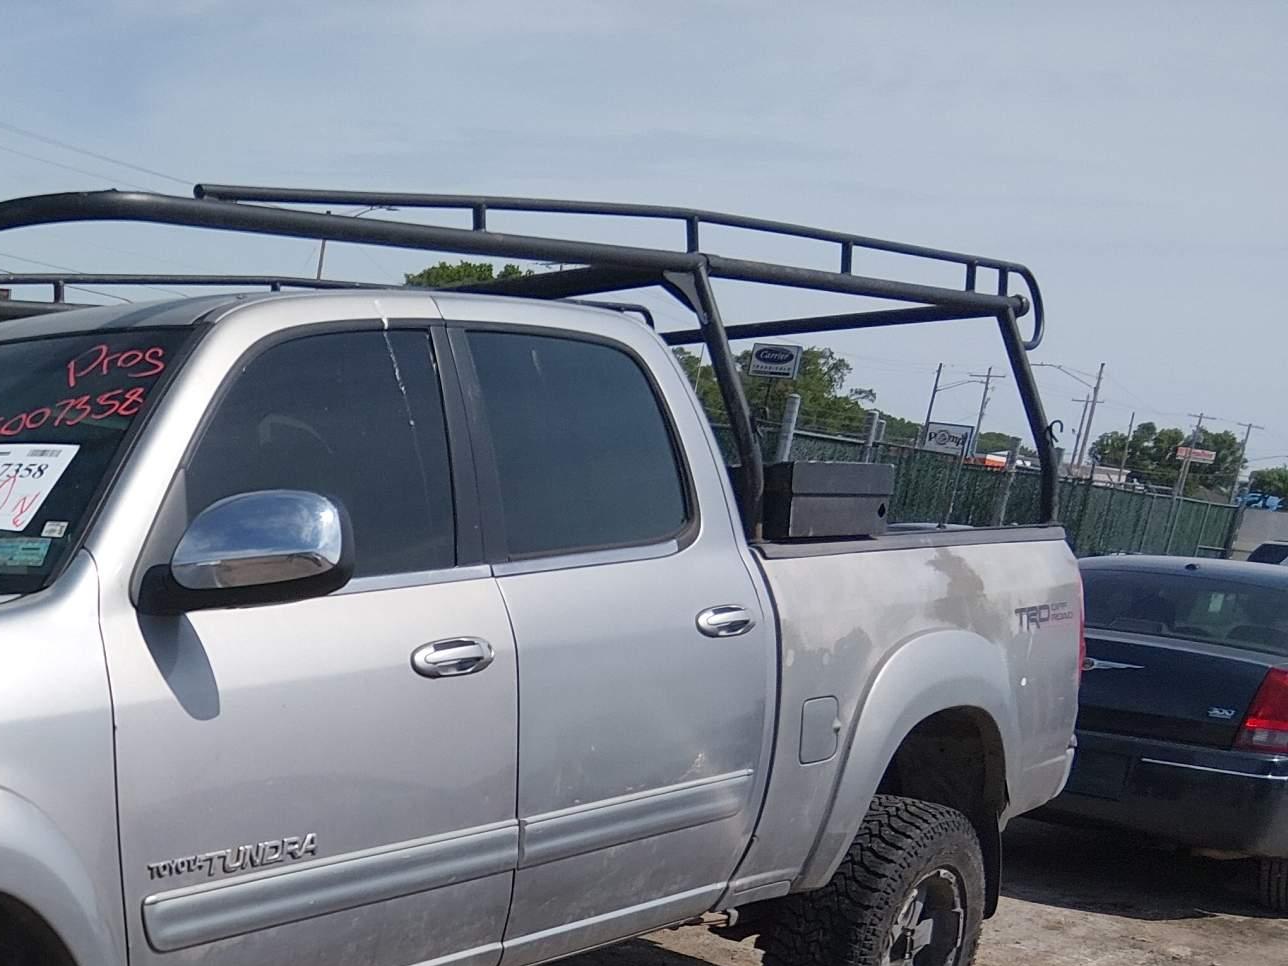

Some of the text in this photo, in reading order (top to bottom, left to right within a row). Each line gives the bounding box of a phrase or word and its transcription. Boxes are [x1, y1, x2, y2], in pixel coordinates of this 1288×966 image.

[759, 350, 790, 361] Carrier
[1014, 603, 1050, 631] TRD
[146, 833, 318, 880] TOYOTA TUNDRA
